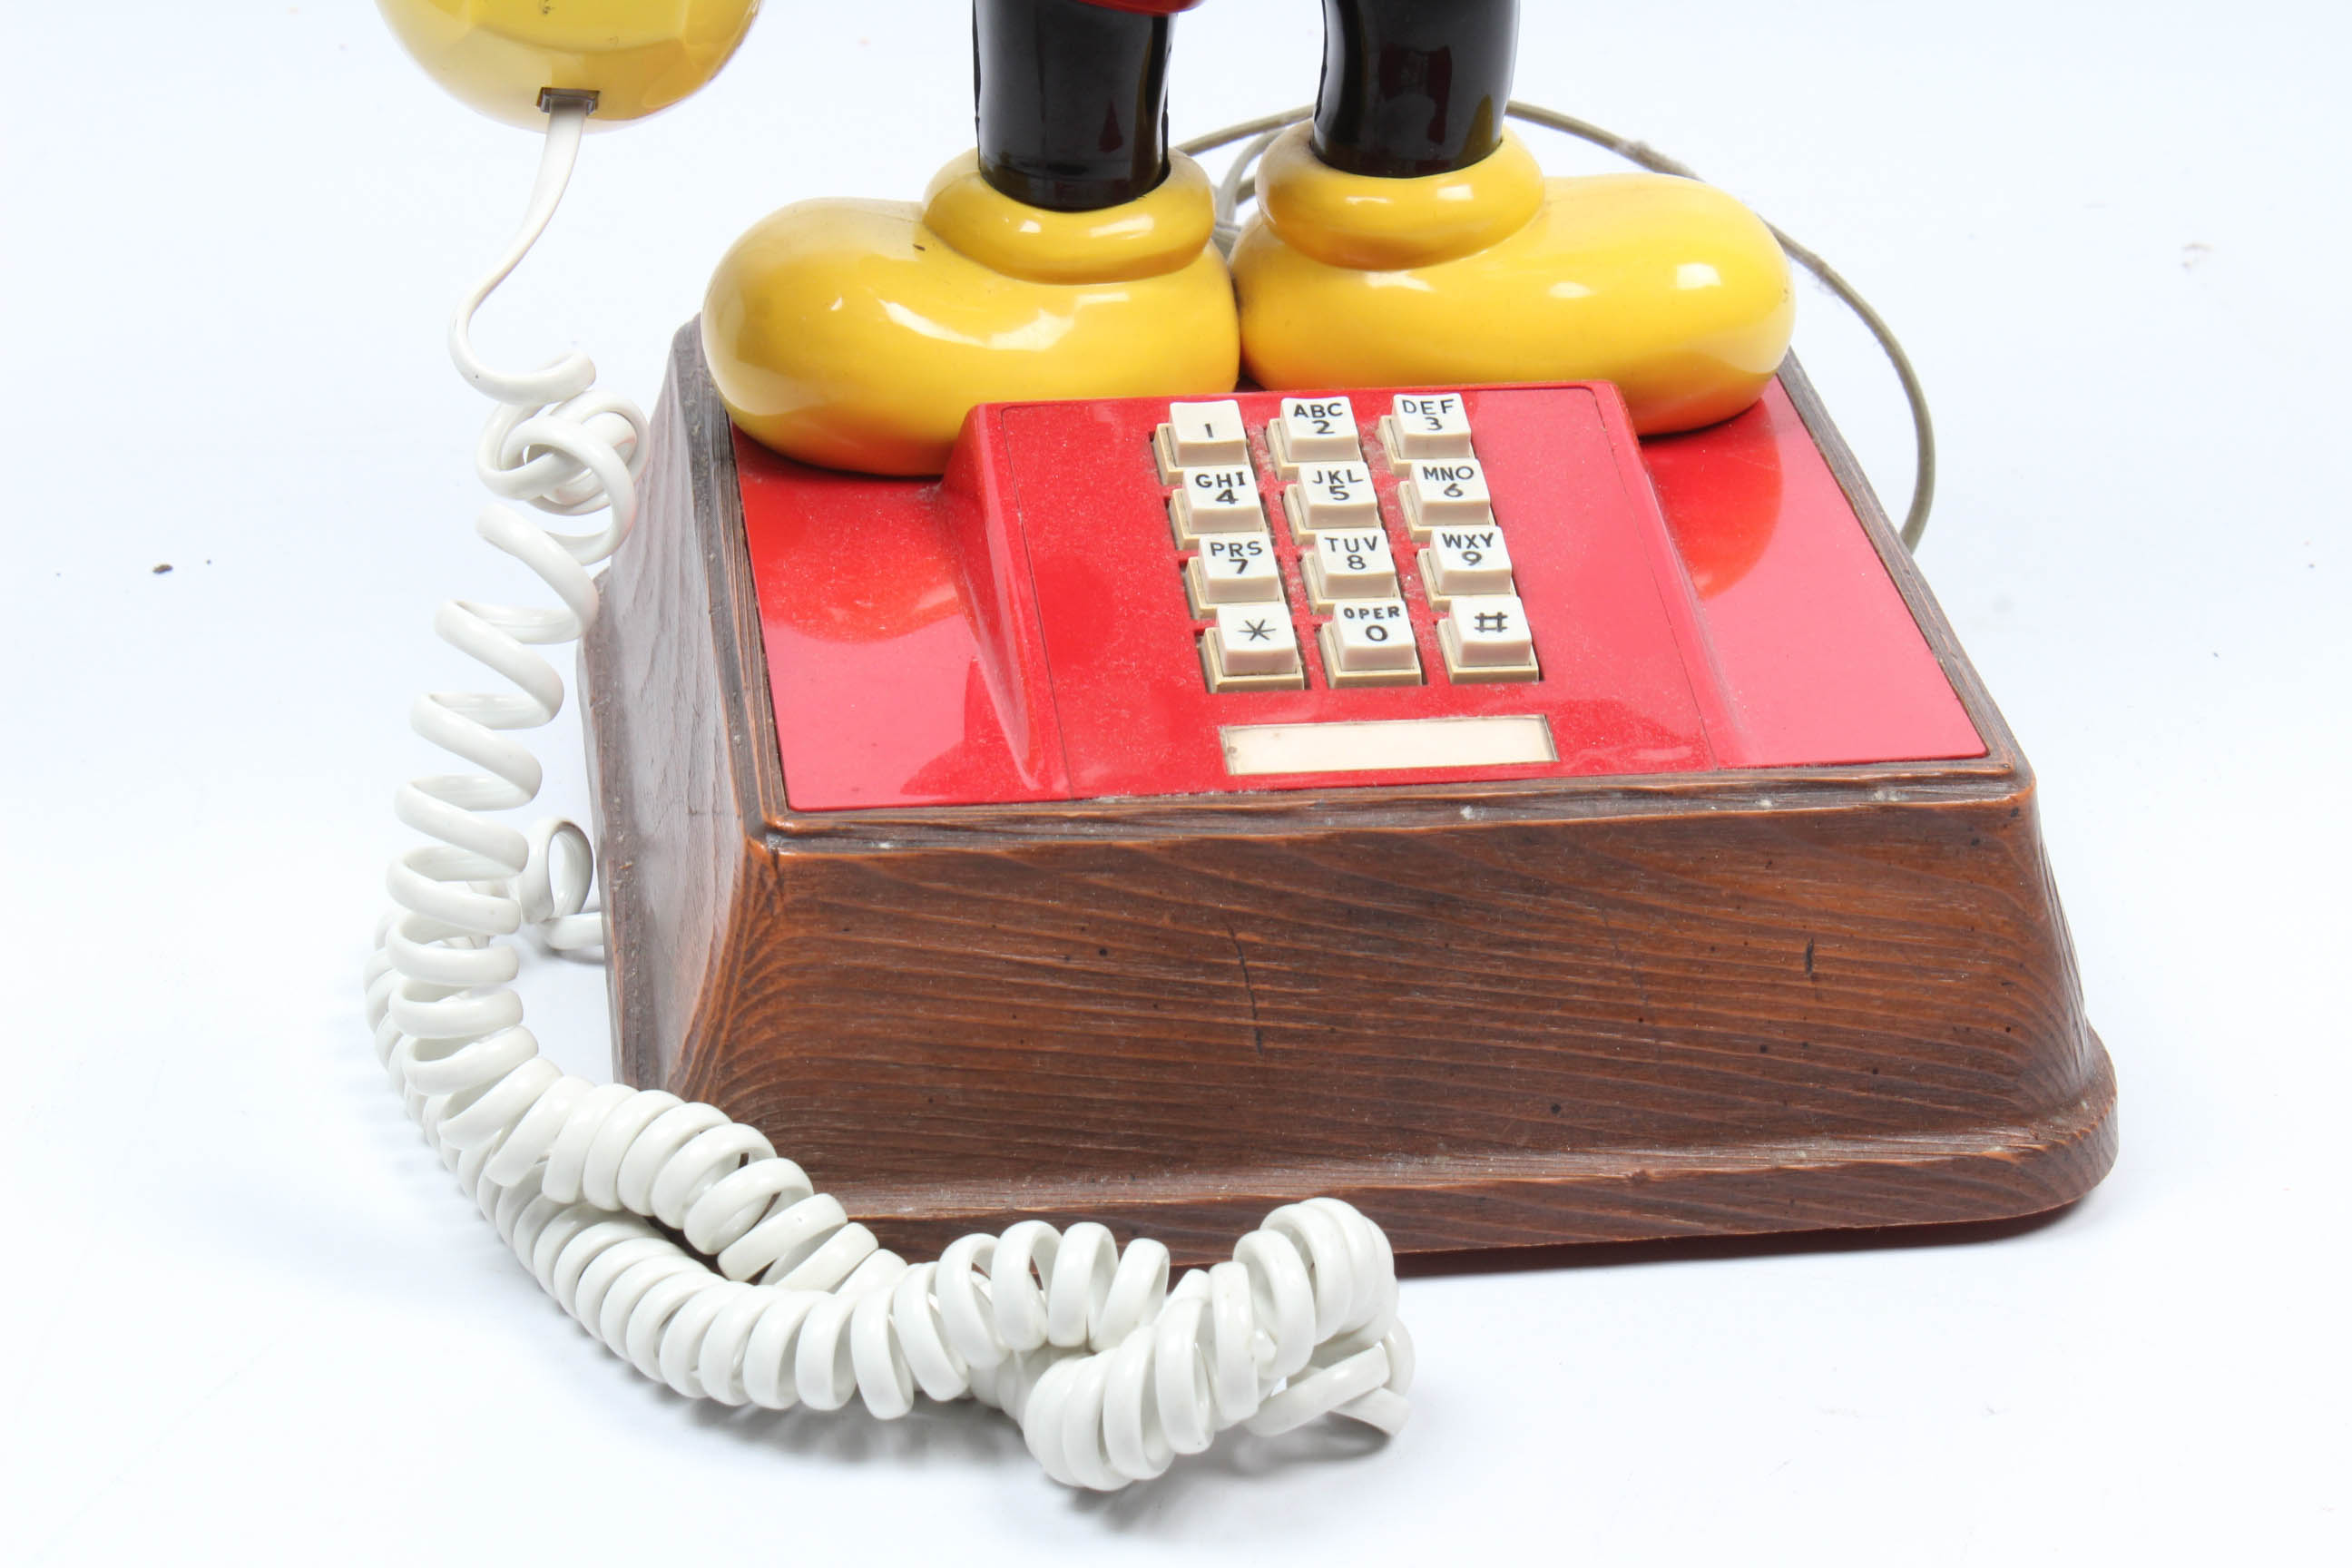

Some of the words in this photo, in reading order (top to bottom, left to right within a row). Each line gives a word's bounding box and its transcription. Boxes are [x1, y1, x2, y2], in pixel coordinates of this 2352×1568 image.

[1293, 402, 1343, 418] ABC
[1402, 398, 1454, 416] DEF
[1312, 419, 1335, 435] 2
[1426, 416, 1443, 431] 3
[1195, 471, 1246, 491] GHI
[1313, 469, 1363, 485] JKL
[1422, 466, 1475, 481] MNO
[1215, 488, 1239, 505] 4
[1328, 485, 1350, 501] 5
[1444, 483, 1464, 497] 6
[1325, 535, 1377, 554] TUV
[1442, 532, 1494, 549] WXY
[1210, 541, 1263, 558] PRS
[1229, 558, 1249, 574] 7
[1347, 554, 1367, 570] 8
[1462, 551, 1483, 566] 9
[1343, 605, 1400, 620] OPER
